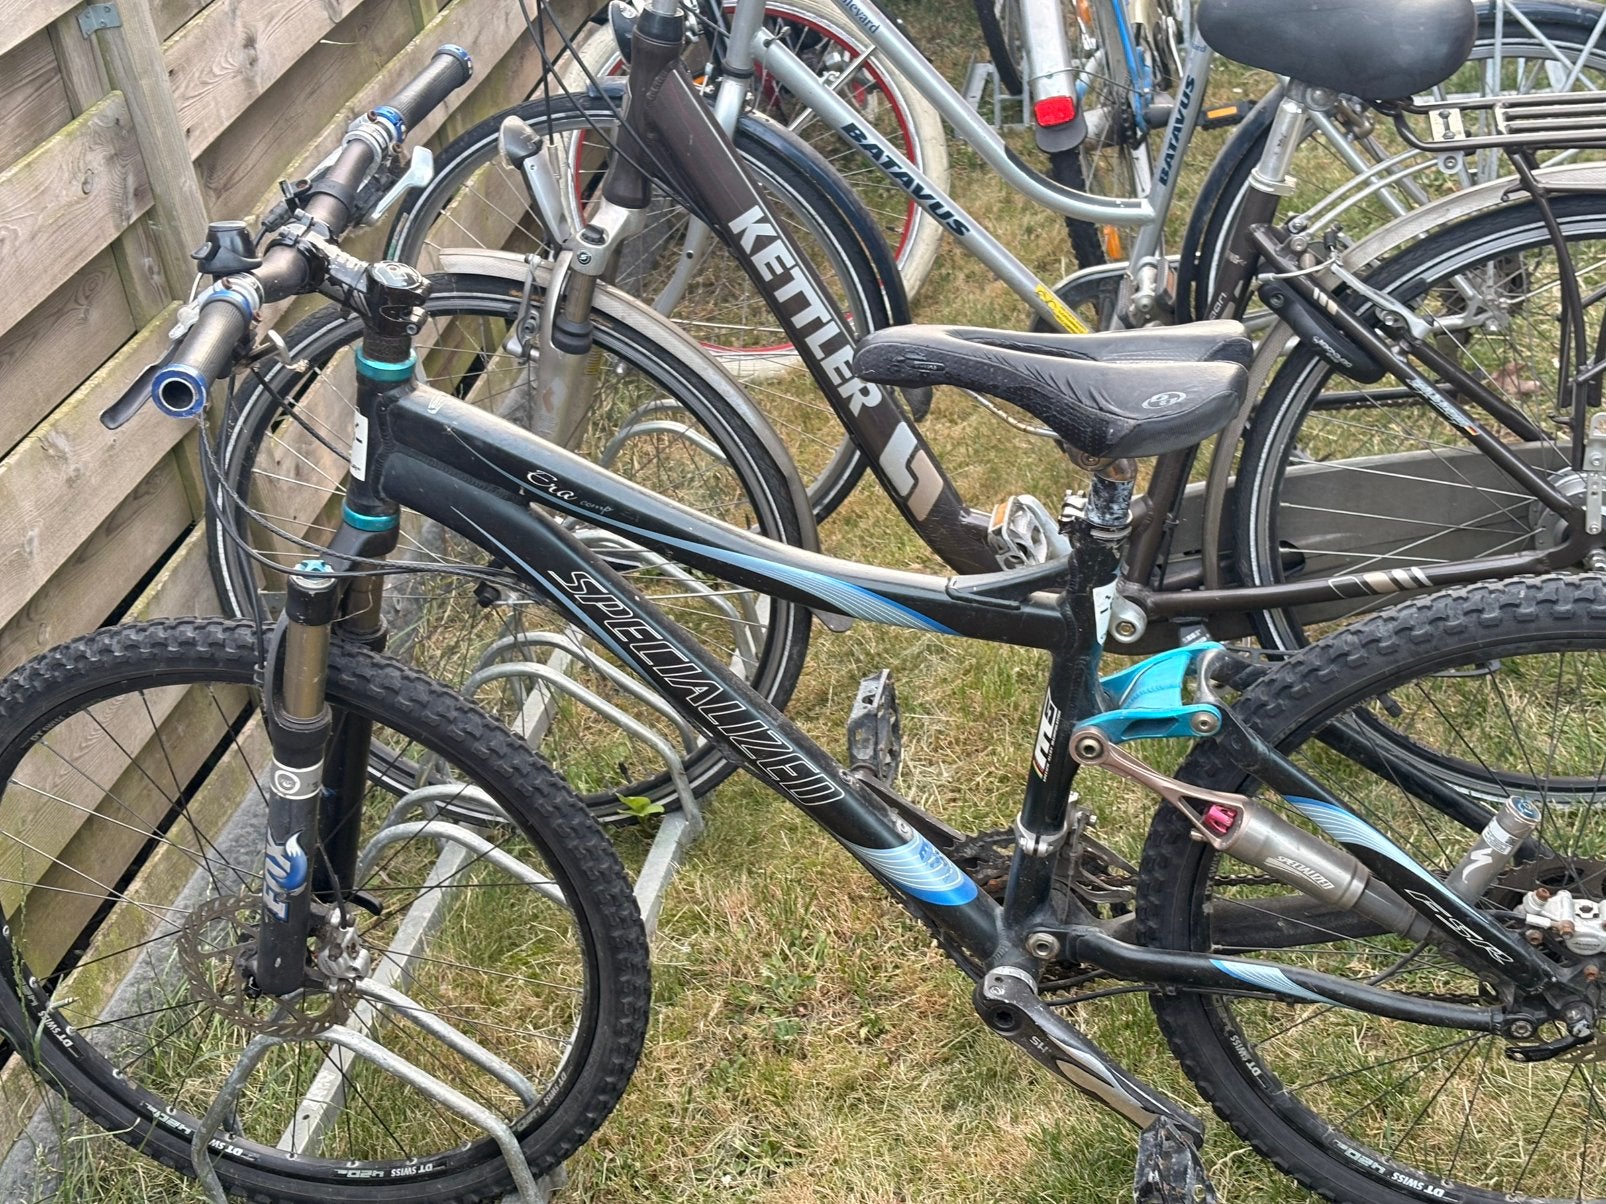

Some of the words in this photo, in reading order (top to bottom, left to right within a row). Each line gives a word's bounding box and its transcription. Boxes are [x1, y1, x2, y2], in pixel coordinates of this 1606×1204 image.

[1158, 75, 1195, 187] BATAVUS
[841, 122, 971, 236] BATAVUS
[728, 204, 882, 417] KETTLER
[527, 470, 578, 500] Era
[580, 501, 615, 515] comp
[548, 570, 846, 806] SPECIALIZED
[1275, 855, 1336, 889] SPECIALIZED
[1404, 888, 1514, 965] FSR
[54, 1033, 75, 1048] DT
[1230, 1035, 1252, 1061] SWISS
[557, 1071, 568, 1088] DT
[1246, 1061, 1262, 1077] DT
[543, 1084, 560, 1106] SWISS
[224, 1144, 244, 1157] DT
[390, 1165, 417, 1177] SWISS
[418, 1163, 434, 1174] DT
[1391, 1172, 1425, 1191] SWISS
[1424, 1184, 1446, 1199] DT
